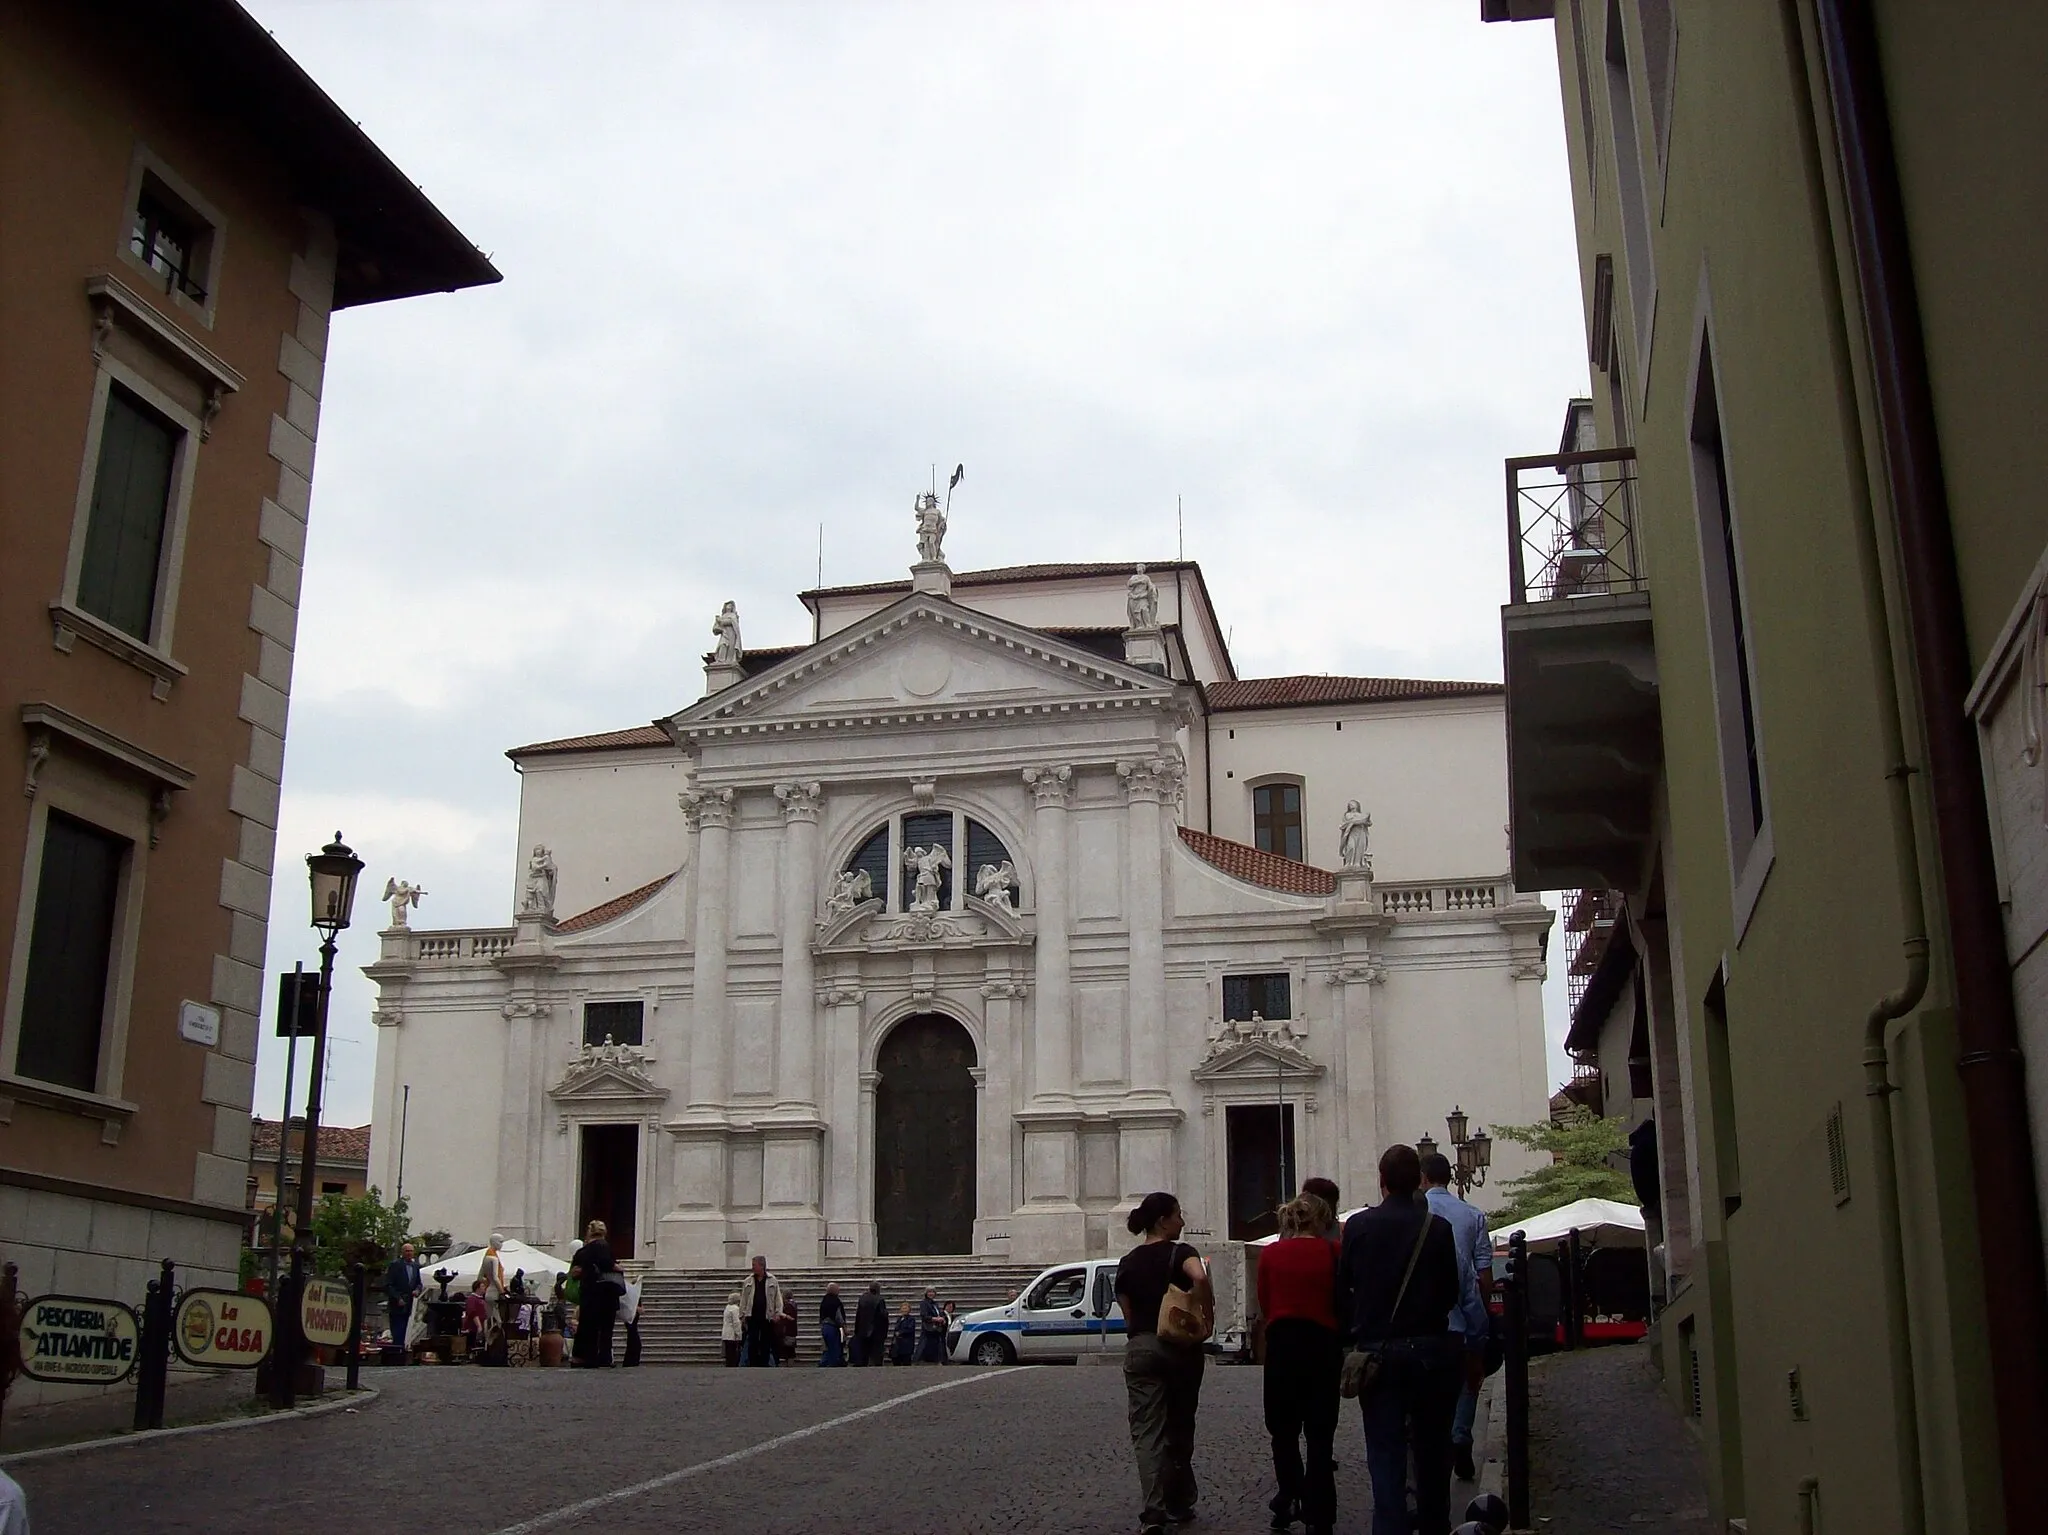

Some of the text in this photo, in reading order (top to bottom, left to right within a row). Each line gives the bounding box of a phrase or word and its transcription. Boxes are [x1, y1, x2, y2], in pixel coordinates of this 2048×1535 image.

[308, 1284, 323, 1302] del
[37, 1306, 105, 1330] PESCHERIA
[220, 1302, 238, 1321] La
[305, 1307, 348, 1333] PROSCIUTTO
[36, 1332, 132, 1361] ATLANTIDE
[215, 1327, 262, 1353] CASA
